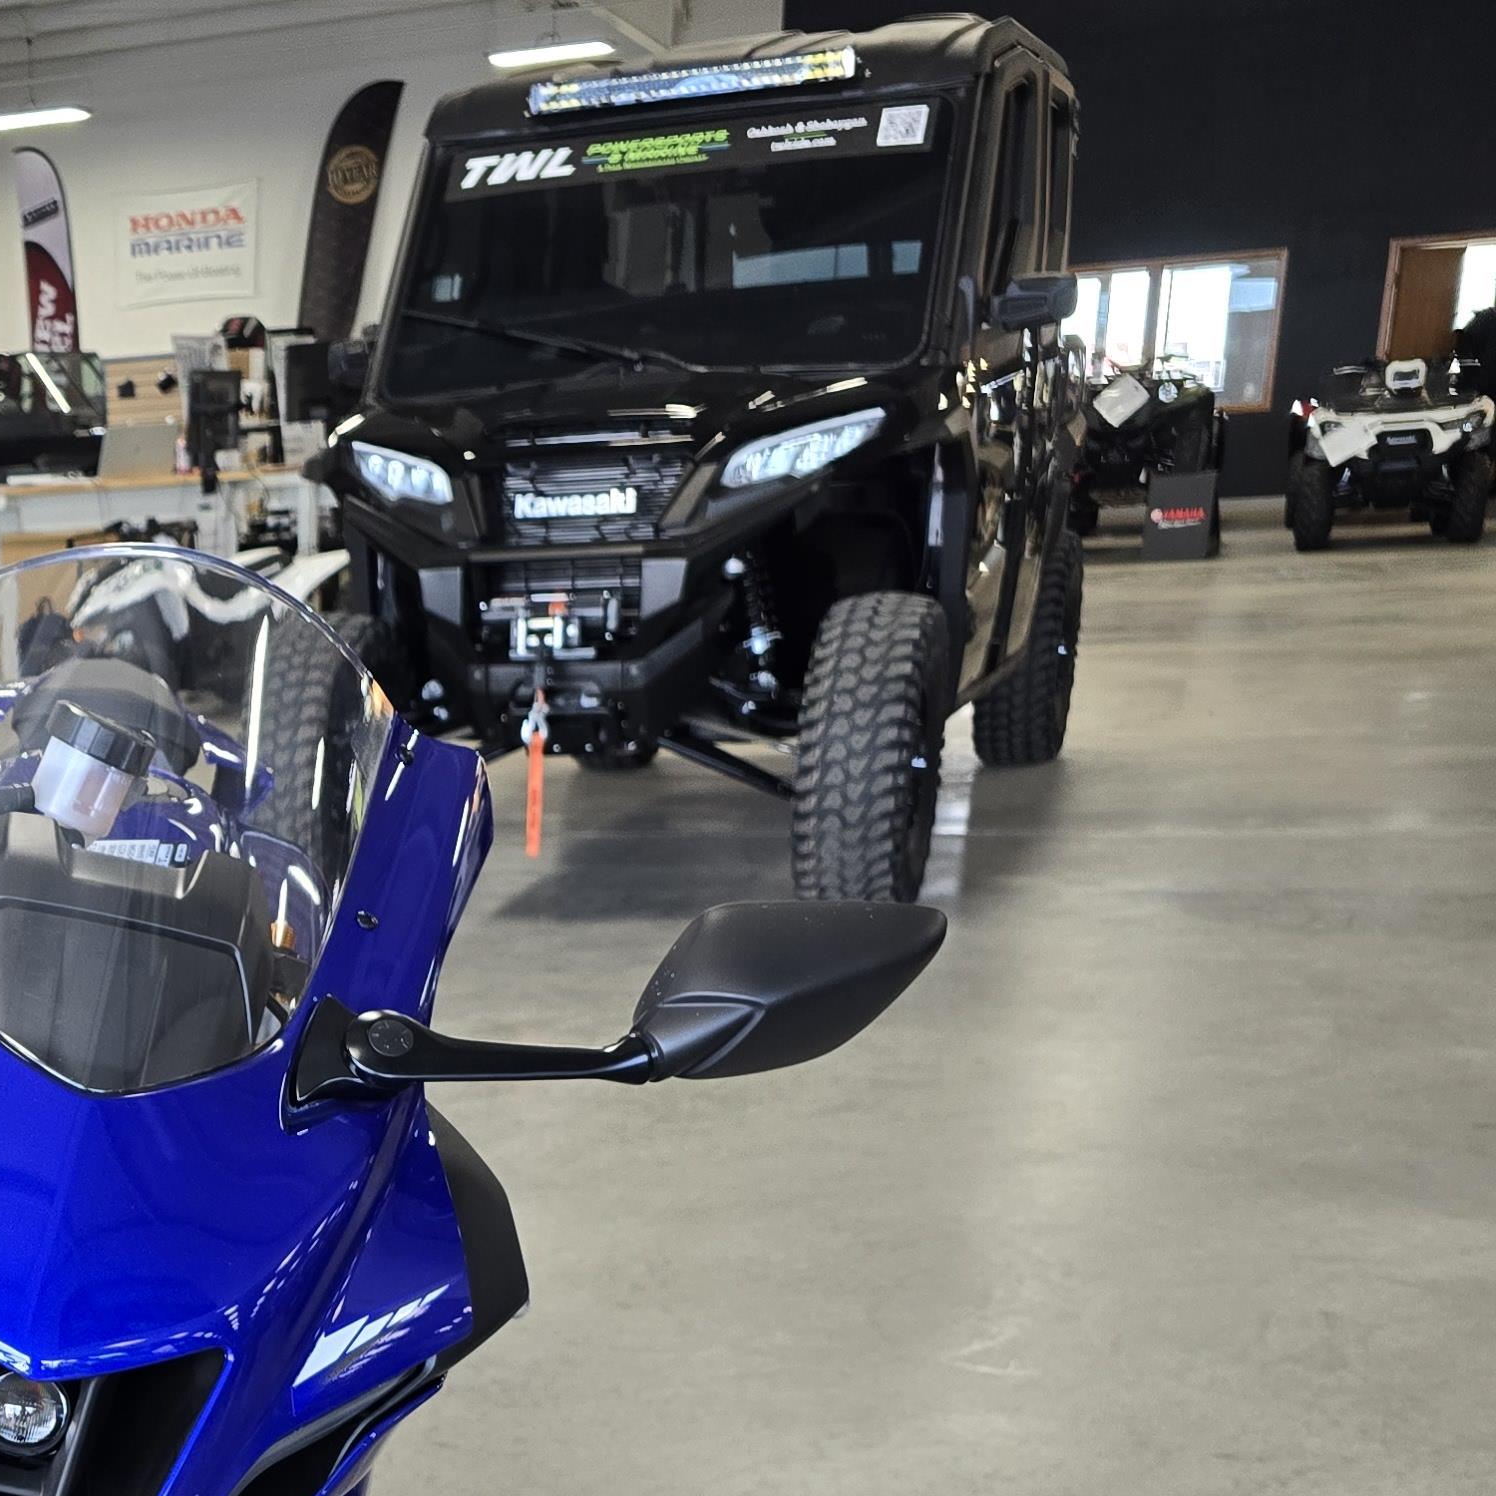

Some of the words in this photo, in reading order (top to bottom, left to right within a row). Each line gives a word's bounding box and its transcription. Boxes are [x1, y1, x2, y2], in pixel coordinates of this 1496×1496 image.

[460, 147, 576, 190] TWL
[129, 205, 246, 234] HONDA
[130, 230, 246, 258] MARINE
[514, 487, 638, 519] Kawasaki
